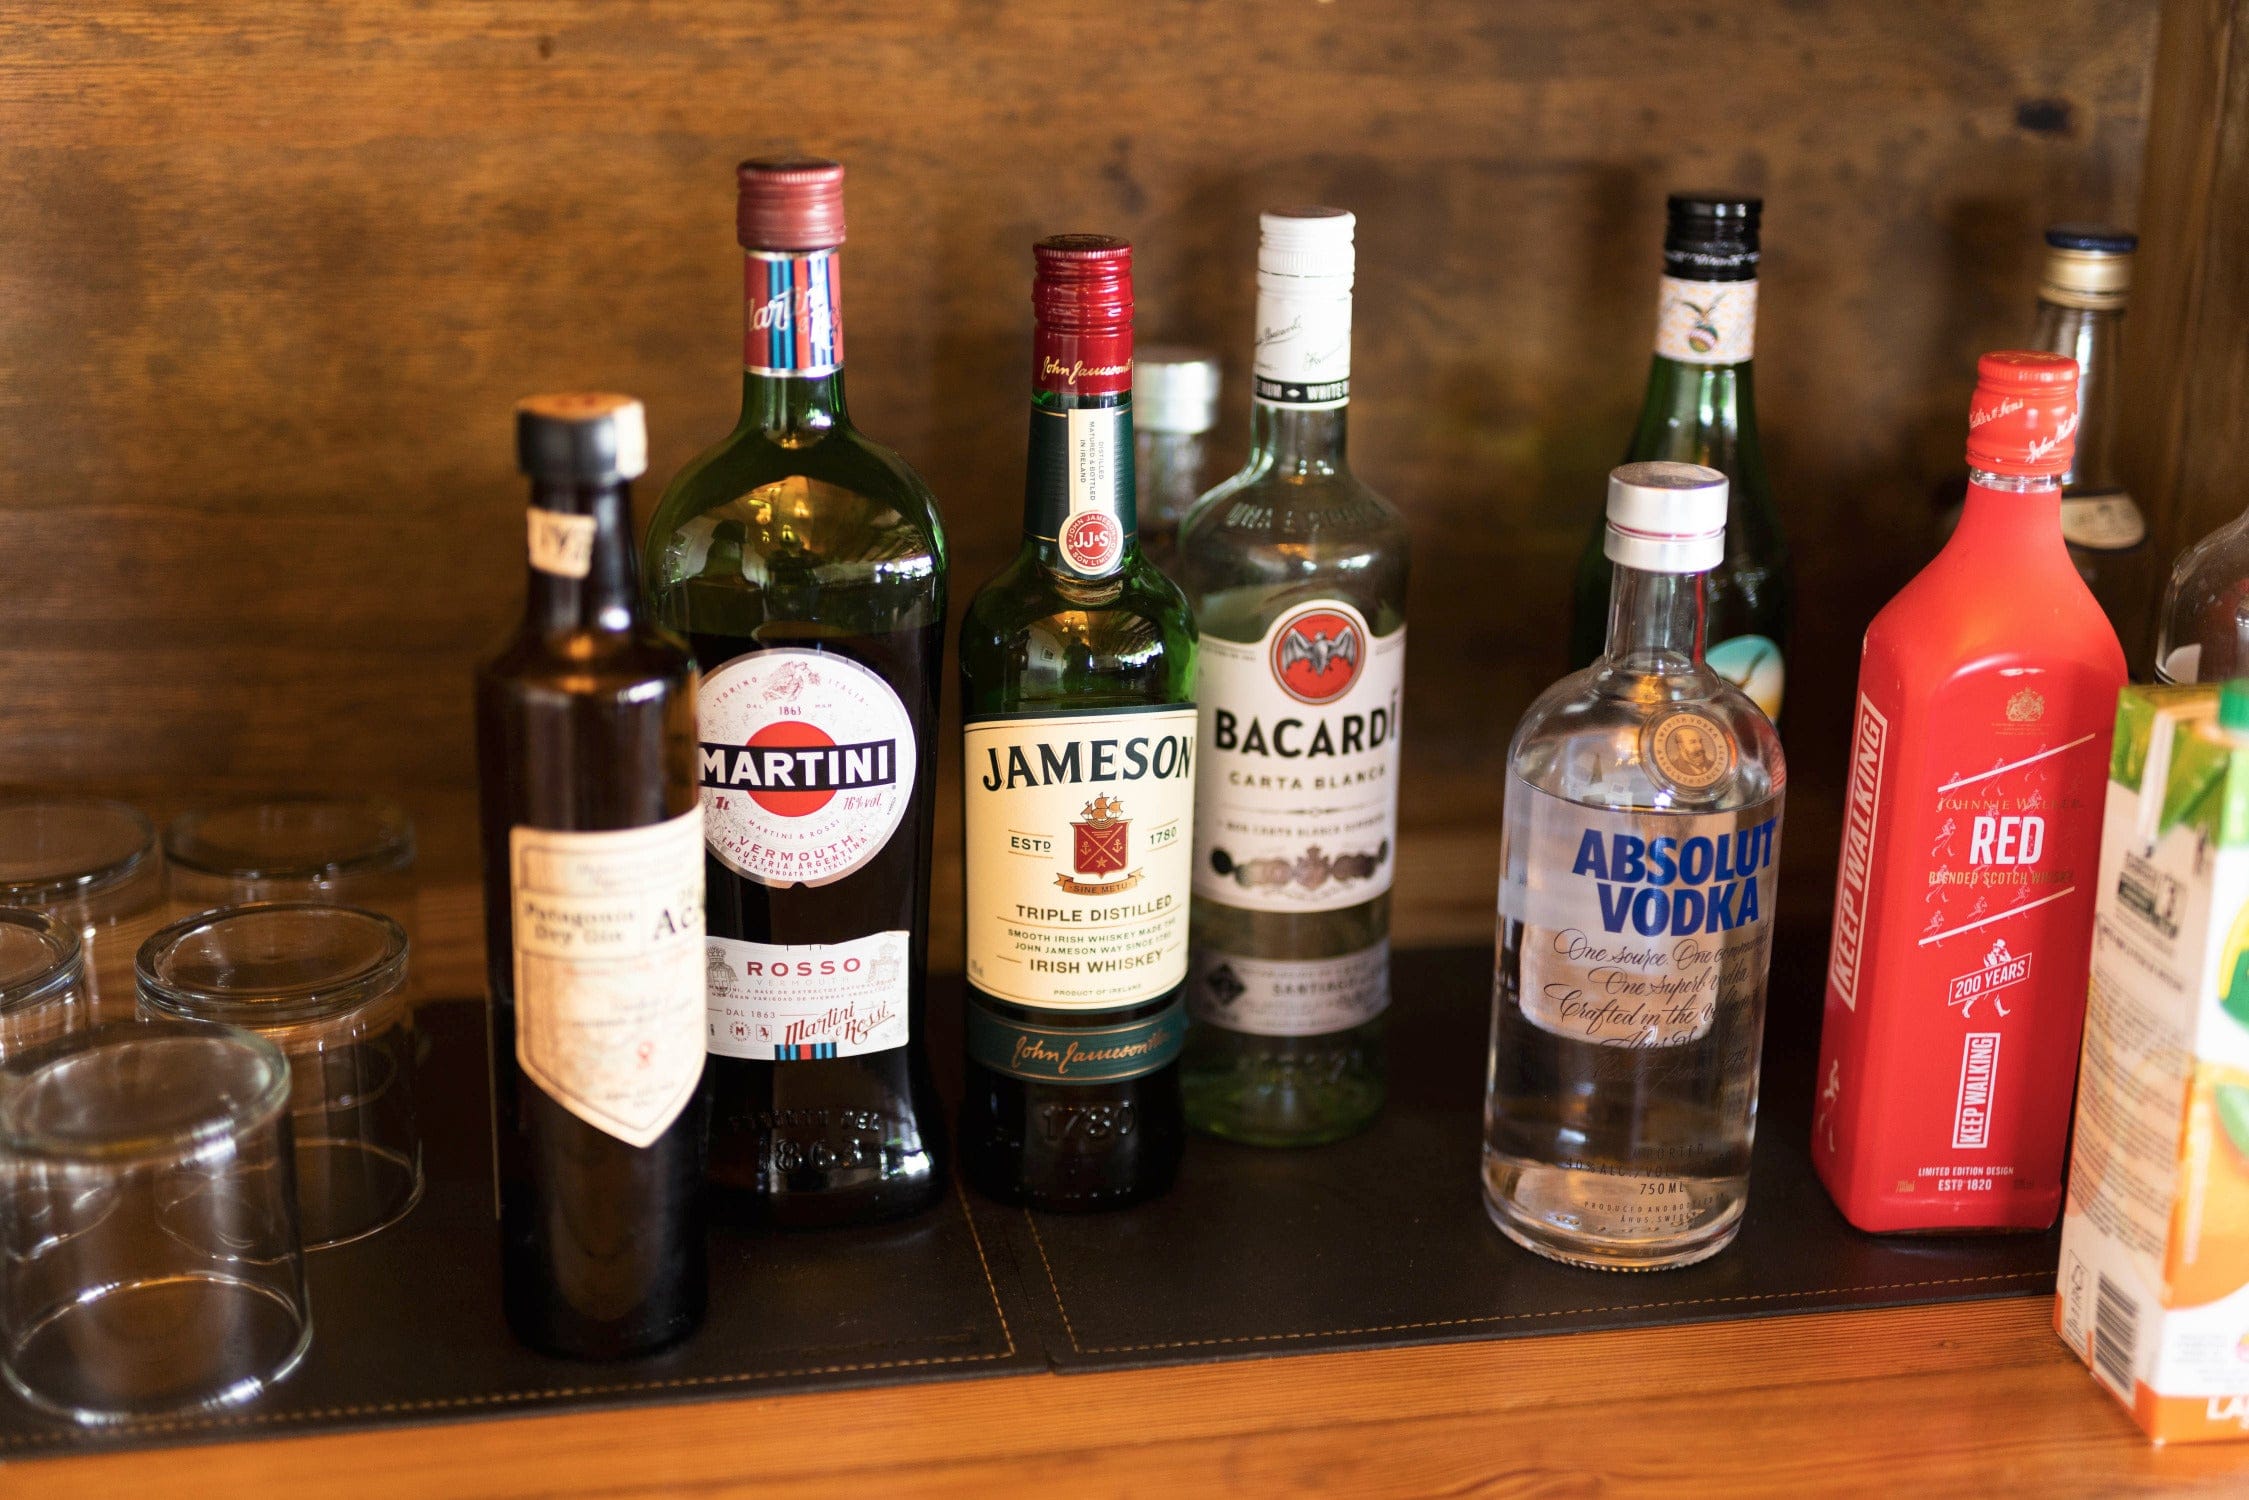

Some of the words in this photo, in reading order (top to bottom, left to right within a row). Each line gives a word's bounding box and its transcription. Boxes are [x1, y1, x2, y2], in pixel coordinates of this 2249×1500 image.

[1041, 355, 1069, 381] John
[1080, 439, 1085, 448] IN
[1068, 518, 1084, 538] JOHN
[1073, 530, 1109, 548] JJ&S
[1072, 551, 1089, 565] SON
[716, 676, 757, 704] TORINO
[1214, 687, 1400, 758] BACARDÍ
[699, 745, 888, 787] MARTINI
[983, 735, 1193, 792] JAMESON
[1229, 770, 1302, 790] CARTA
[1314, 764, 1386, 790] BLANCA
[1846, 712, 1881, 892] WALKING
[749, 819, 793, 840] MARTINI
[810, 819, 840, 838] ROSSI
[1149, 826, 1178, 846] 1780
[1969, 815, 2045, 865] RED
[722, 837, 789, 870] INDUSTRIA
[798, 837, 868, 870] ARGENTINA
[739, 835, 855, 862] VERMOUTH
[1572, 816, 1777, 886] ABSOLUT
[1073, 884, 1099, 895] SINE
[1928, 871, 1978, 885] BLENDED
[1983, 871, 2027, 885] SCOTCH
[1016, 904, 1082, 922] TRIPLE
[1090, 894, 1172, 922] DISTILLED
[1597, 876, 1759, 937] VODKA
[1008, 928, 1051, 942] SMOOTH
[1054, 935, 1084, 943] IRISH
[1088, 931, 1136, 943] WHISKEY
[1138, 925, 1162, 937] MADE
[1015, 942, 1041, 953] JOHN
[1045, 946, 1096, 955] JAMESON
[1100, 945, 1123, 955] WAY
[1126, 939, 1152, 950] SINCE
[1835, 888, 1859, 982] KEEP
[1030, 959, 1080, 973] IRISH
[1087, 950, 1163, 973] WHISKEY
[1553, 928, 1607, 961] One
[1606, 945, 1669, 971] source.
[1672, 938, 1712, 970] One
[747, 957, 861, 977] ROSSO
[1954, 977, 1981, 999] 200
[1984, 959, 2026, 990] YEARS
[756, 976, 849, 987] VERMOUTH
[1053, 989, 1093, 997] PRODUCT
[1588, 966, 1645, 995] One
[1648, 967, 1707, 1004] superb
[726, 1009, 745, 1017] DAL
[751, 1010, 776, 1019] 1863
[1544, 983, 1635, 1035] Crafted
[1640, 1008, 1659, 1026] in
[1661, 995, 1697, 1025] the
[784, 1001, 854, 1050] Martini
[1011, 1036, 1059, 1070] John
[1058, 1040, 1148, 1075] Jameson
[1963, 1036, 1993, 1106] WALKING
[1959, 1107, 1985, 1143] KEEP
[1918, 1167, 1950, 1177] LIMITED
[1952, 1166, 1984, 1176] EDITION
[1986, 1166, 2014, 1176] DESIGN
[1967, 1178, 1992, 1191] 1820
[1584, 1202, 1642, 1213] PRODUCED
